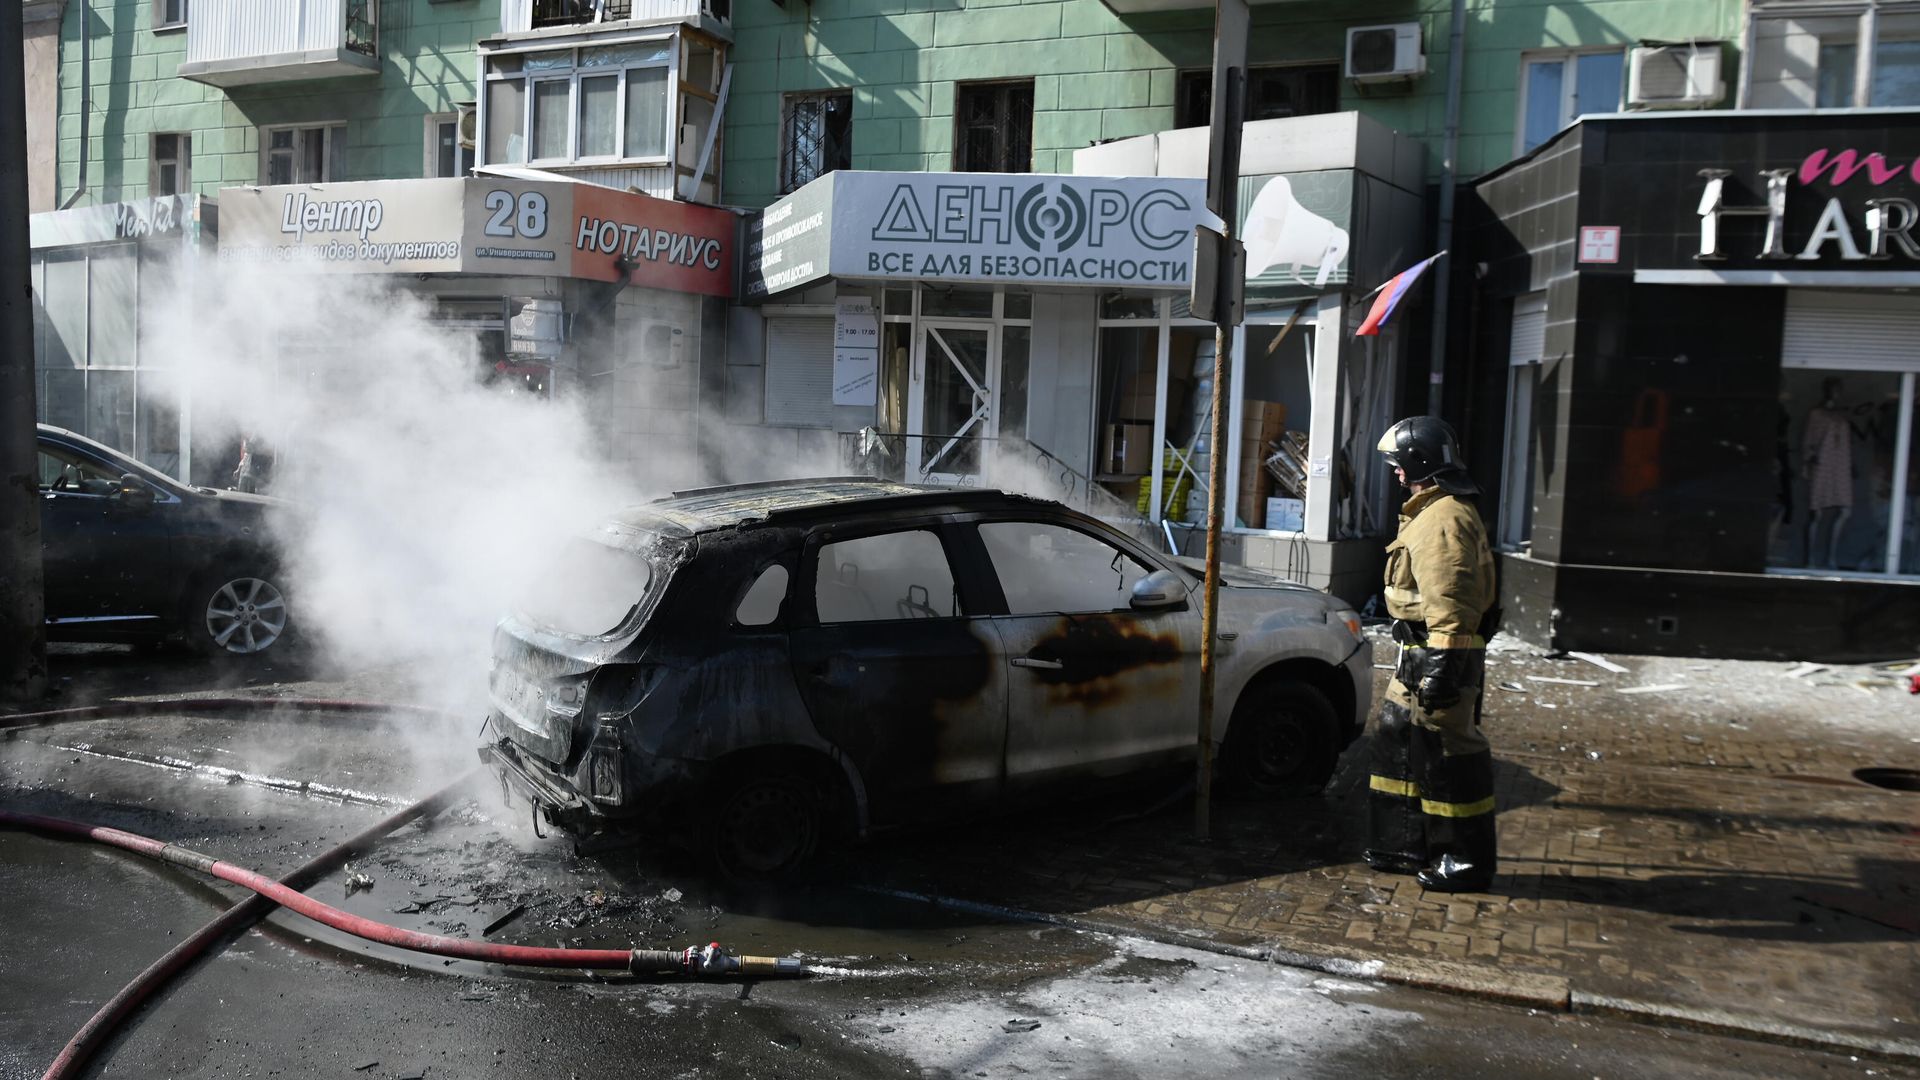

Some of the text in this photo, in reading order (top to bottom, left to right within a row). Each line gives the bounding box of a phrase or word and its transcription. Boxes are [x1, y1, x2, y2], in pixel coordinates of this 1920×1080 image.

[1798, 149, 1920, 186] m
[281, 192, 383, 242] Центр
[484, 190, 548, 239] 28
[872, 182, 1191, 253] ДЕНОРС
[311, 239, 356, 261] видов
[360, 240, 458, 264] документов
[476, 246, 555, 261] ул. Университетская
[576, 216, 721, 270] НОТАРИУС
[868, 252, 1187, 281] ВСЕ ДЛЯ БЕЗОПАСНОСТИ
